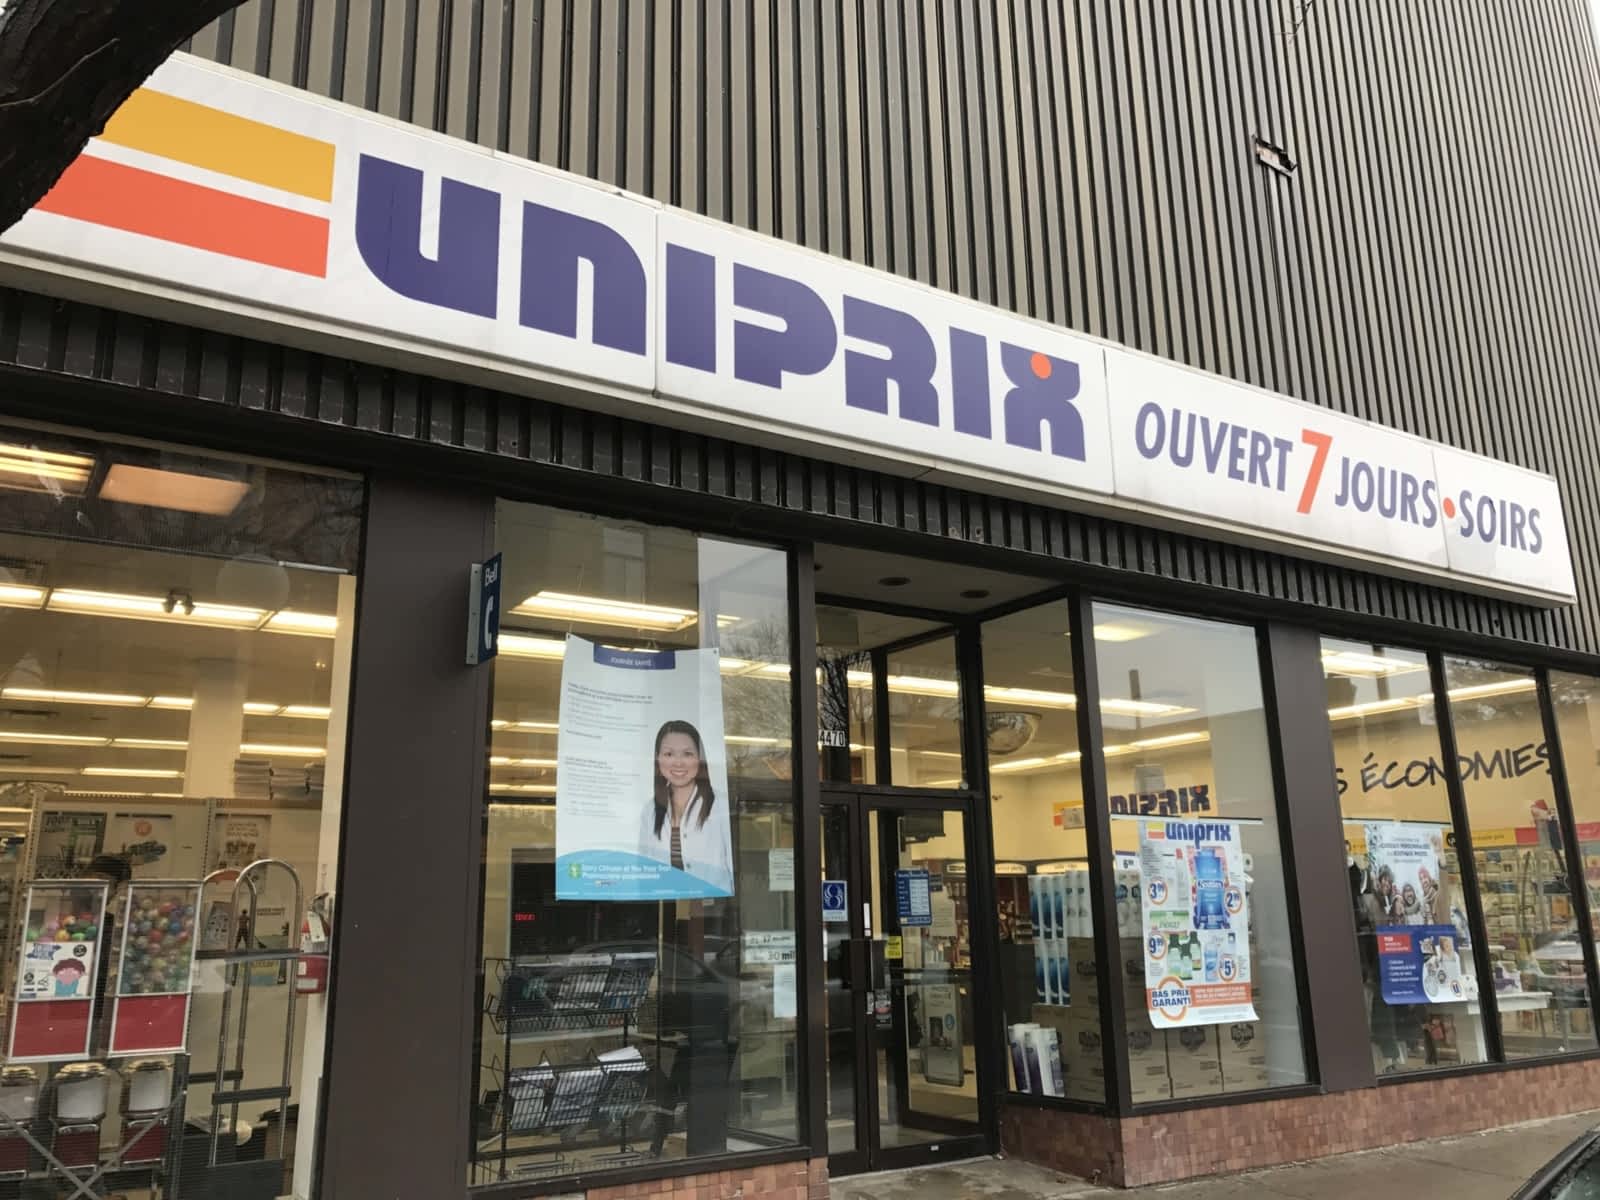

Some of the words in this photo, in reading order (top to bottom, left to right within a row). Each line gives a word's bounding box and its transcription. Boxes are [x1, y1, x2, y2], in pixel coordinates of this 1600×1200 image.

[354, 152, 1086, 463] UNIPRIX
[1135, 401, 1293, 492] OUVERT
[1296, 428, 1334, 515] 7
[1334, 456, 1438, 529] JOURS
[1458, 489, 1543, 554] SOIRS
[484, 562, 499, 586] Bell
